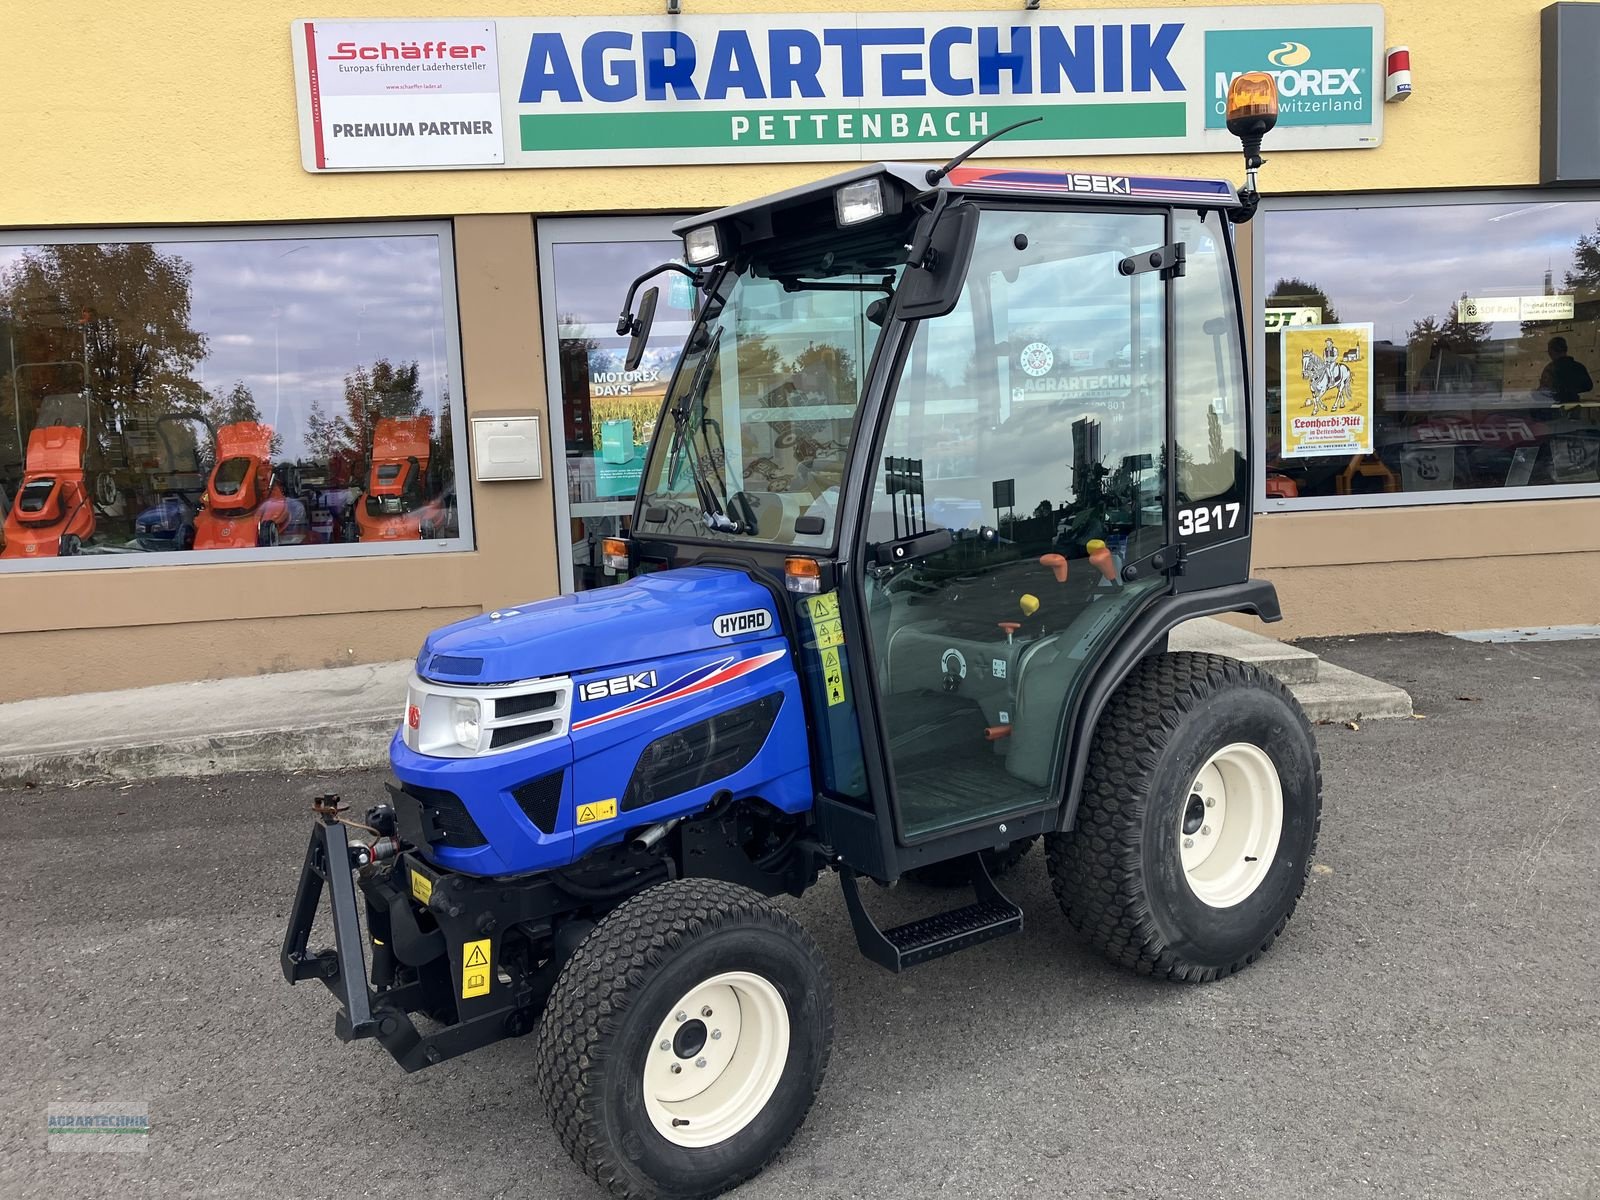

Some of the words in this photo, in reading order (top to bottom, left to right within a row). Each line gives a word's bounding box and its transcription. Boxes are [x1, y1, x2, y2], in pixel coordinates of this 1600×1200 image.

[328, 42, 486, 60] Schäffer
[339, 64, 374, 75] Europas
[376, 63, 420, 73] führender
[422, 62, 486, 72] Laderhersteller
[519, 23, 1187, 104] AGRARTECHNIK
[1215, 68, 1362, 98] MOREX
[1277, 97, 1362, 113] witzerland
[333, 122, 415, 137] PREMIUM
[419, 121, 493, 136] PARTNER
[731, 111, 988, 140] PETTENBACH
[1066, 173, 1131, 194] ISEKI
[594, 371, 659, 383] MOTOREX
[1024, 373, 1148, 392] AGRARTECHNK
[595, 385, 632, 396] DAYS!
[1178, 502, 1241, 536] 3217
[720, 610, 765, 633] HYDRO
[579, 670, 658, 703] ISEKI
